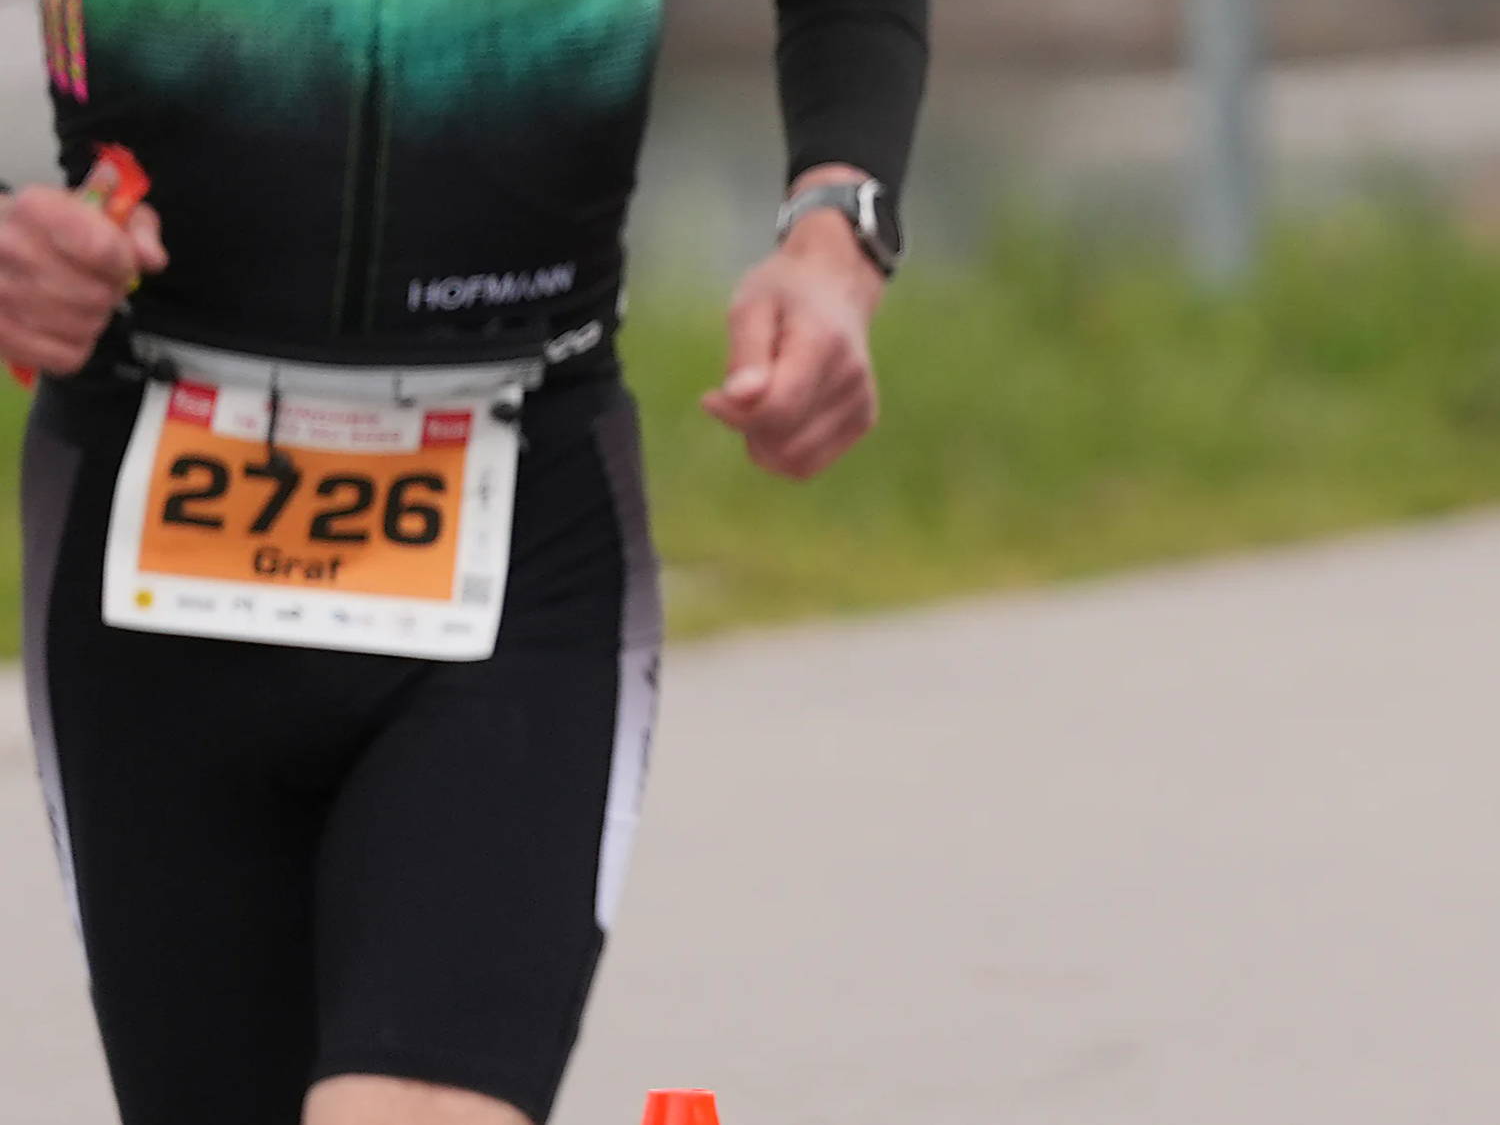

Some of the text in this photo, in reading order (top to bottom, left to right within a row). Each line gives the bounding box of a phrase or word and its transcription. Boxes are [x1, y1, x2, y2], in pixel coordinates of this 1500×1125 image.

[407, 260, 577, 312] HOFMANN
[163, 452, 446, 545] 2726
[254, 547, 343, 581] Graf
